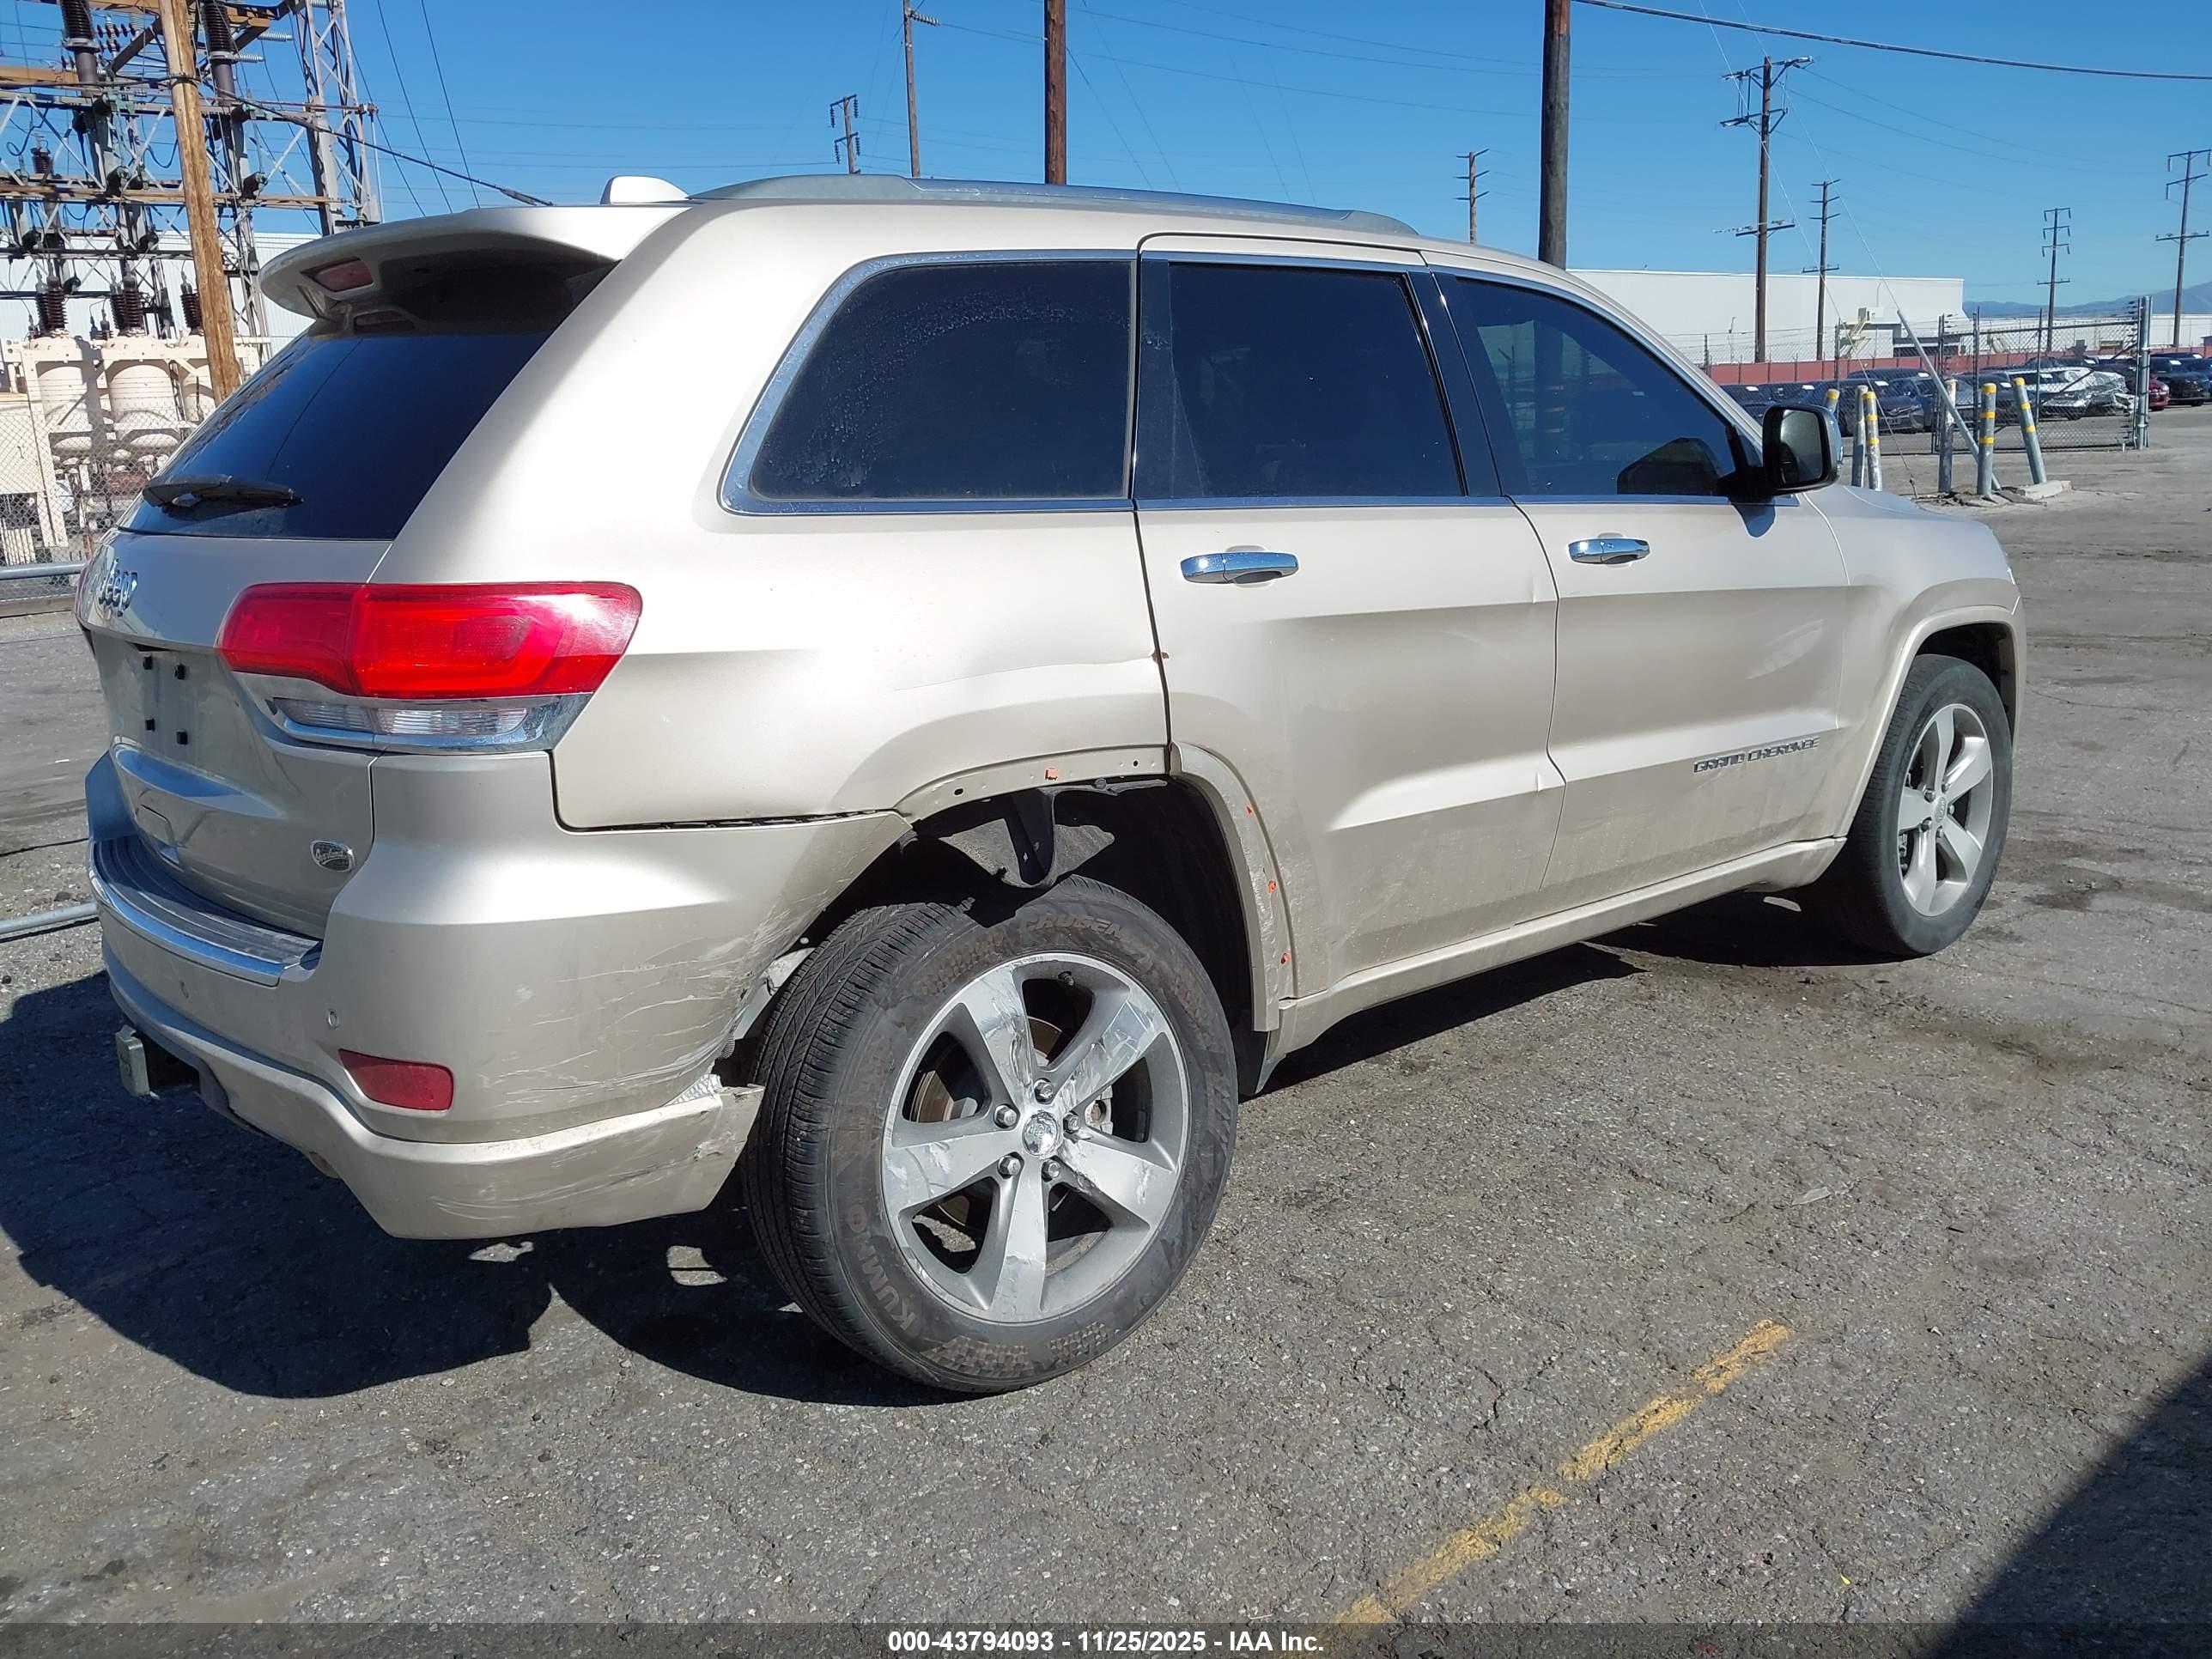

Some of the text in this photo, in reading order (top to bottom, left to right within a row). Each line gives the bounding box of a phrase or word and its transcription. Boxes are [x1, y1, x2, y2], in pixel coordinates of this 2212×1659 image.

[98, 556, 137, 617] Jeep
[1693, 736, 1820, 773] GRAND CHEROKEE
[845, 1204, 916, 1331] KUMHO
